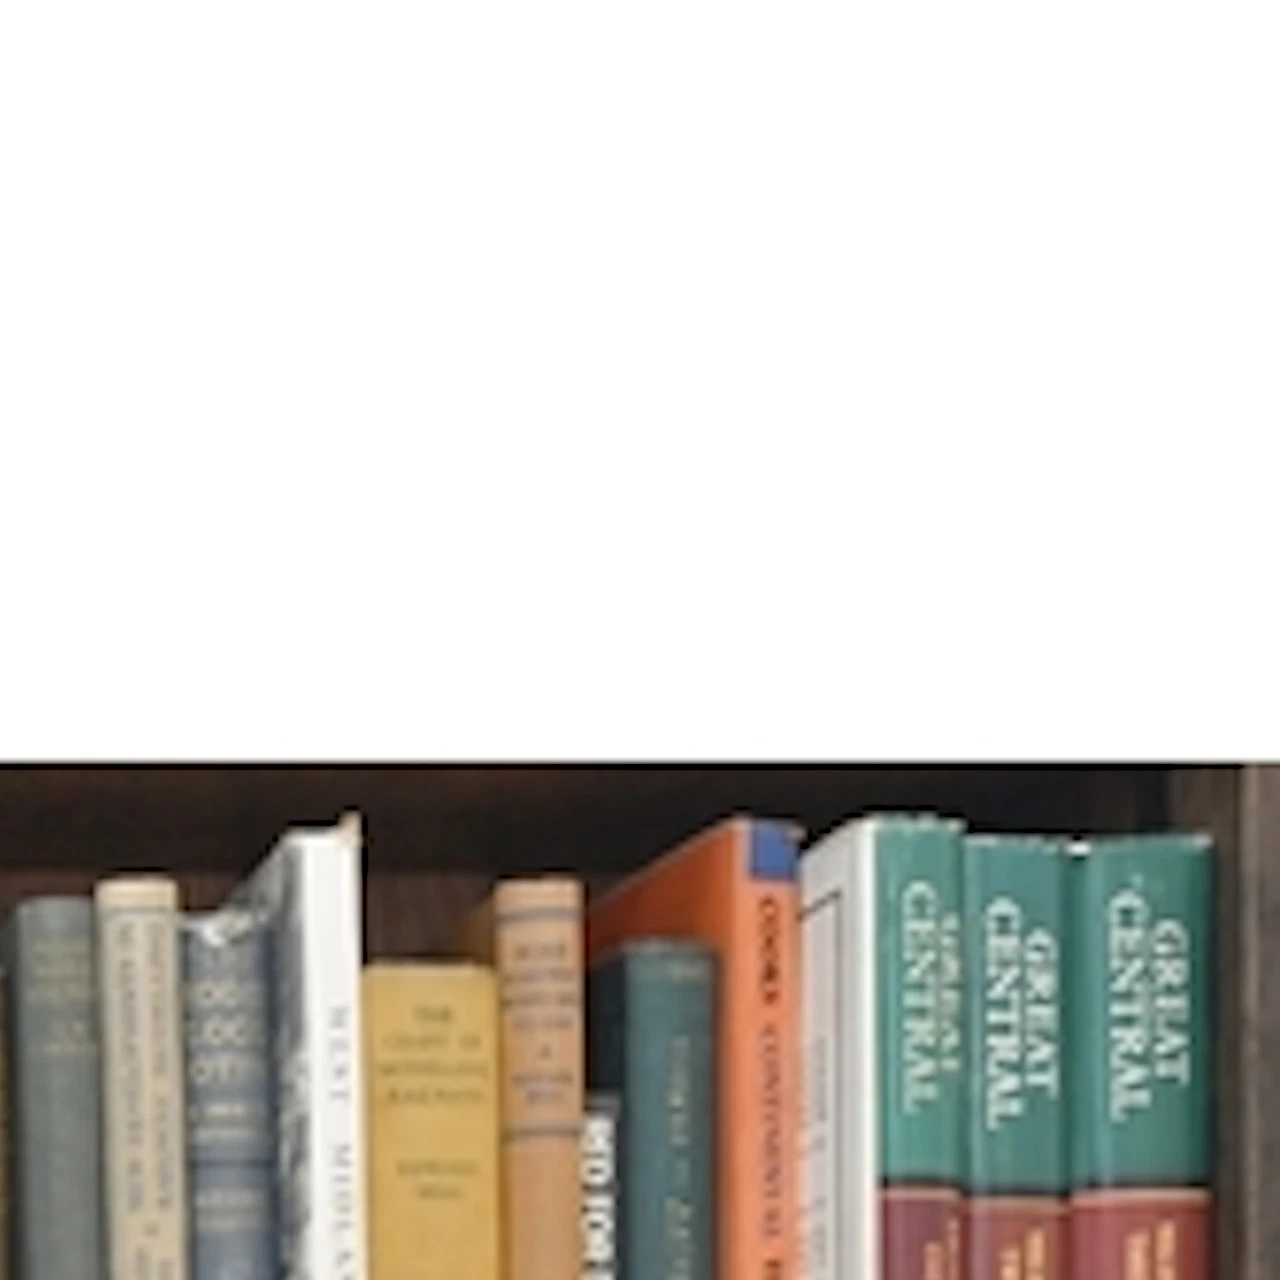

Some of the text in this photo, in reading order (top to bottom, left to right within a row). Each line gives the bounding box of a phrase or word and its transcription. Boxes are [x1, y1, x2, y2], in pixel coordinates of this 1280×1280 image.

[901, 880, 941, 1116] CENTRAL
[984, 894, 1024, 1132] CENTRAL
[1024, 926, 1061, 1099] GREAT
[1107, 889, 1153, 1125] CENTRAL
[1154, 918, 1193, 1089] GREAT
